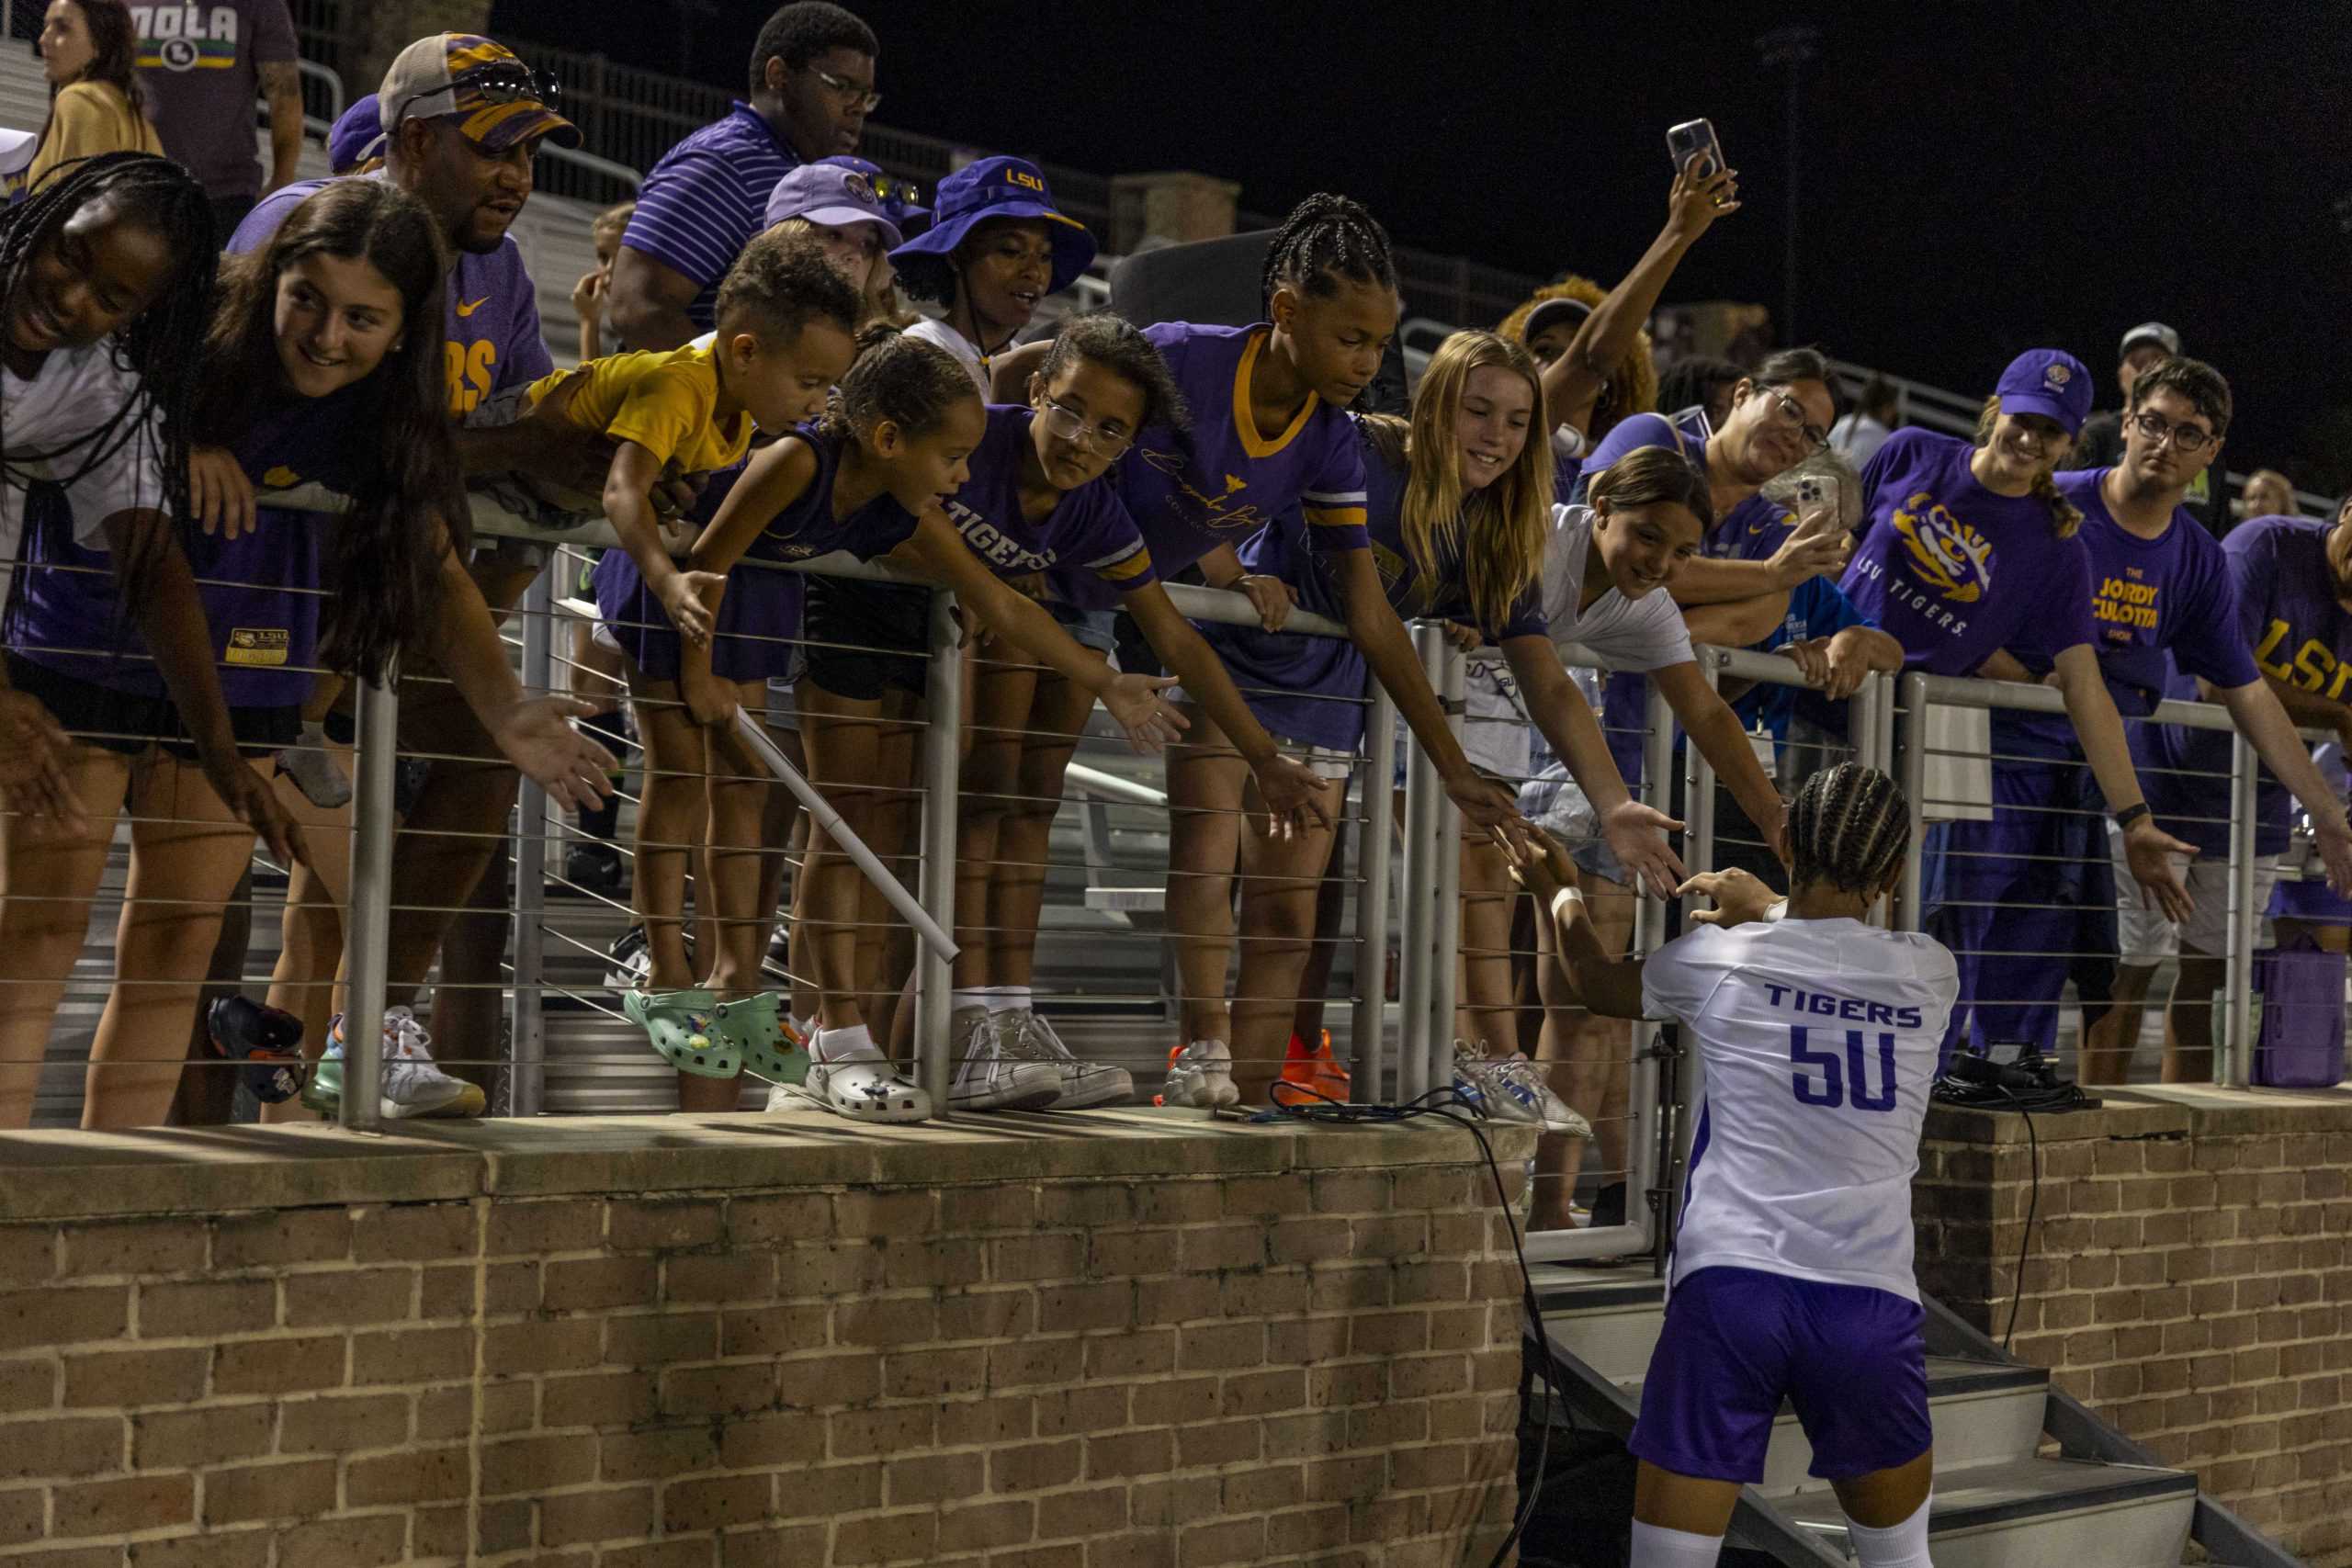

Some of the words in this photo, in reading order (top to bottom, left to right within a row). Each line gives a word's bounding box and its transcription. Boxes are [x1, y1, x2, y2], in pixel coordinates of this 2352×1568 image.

[130, 5, 238, 44] NOLA
[1006, 168, 1044, 192] LSU
[946, 500, 1057, 570] TIGERS
[1858, 556, 1884, 581] LSU
[2098, 576, 2159, 606] JORDY
[2090, 597, 2158, 629] CULOTTA
[1763, 982, 1923, 1030] TIGERS
